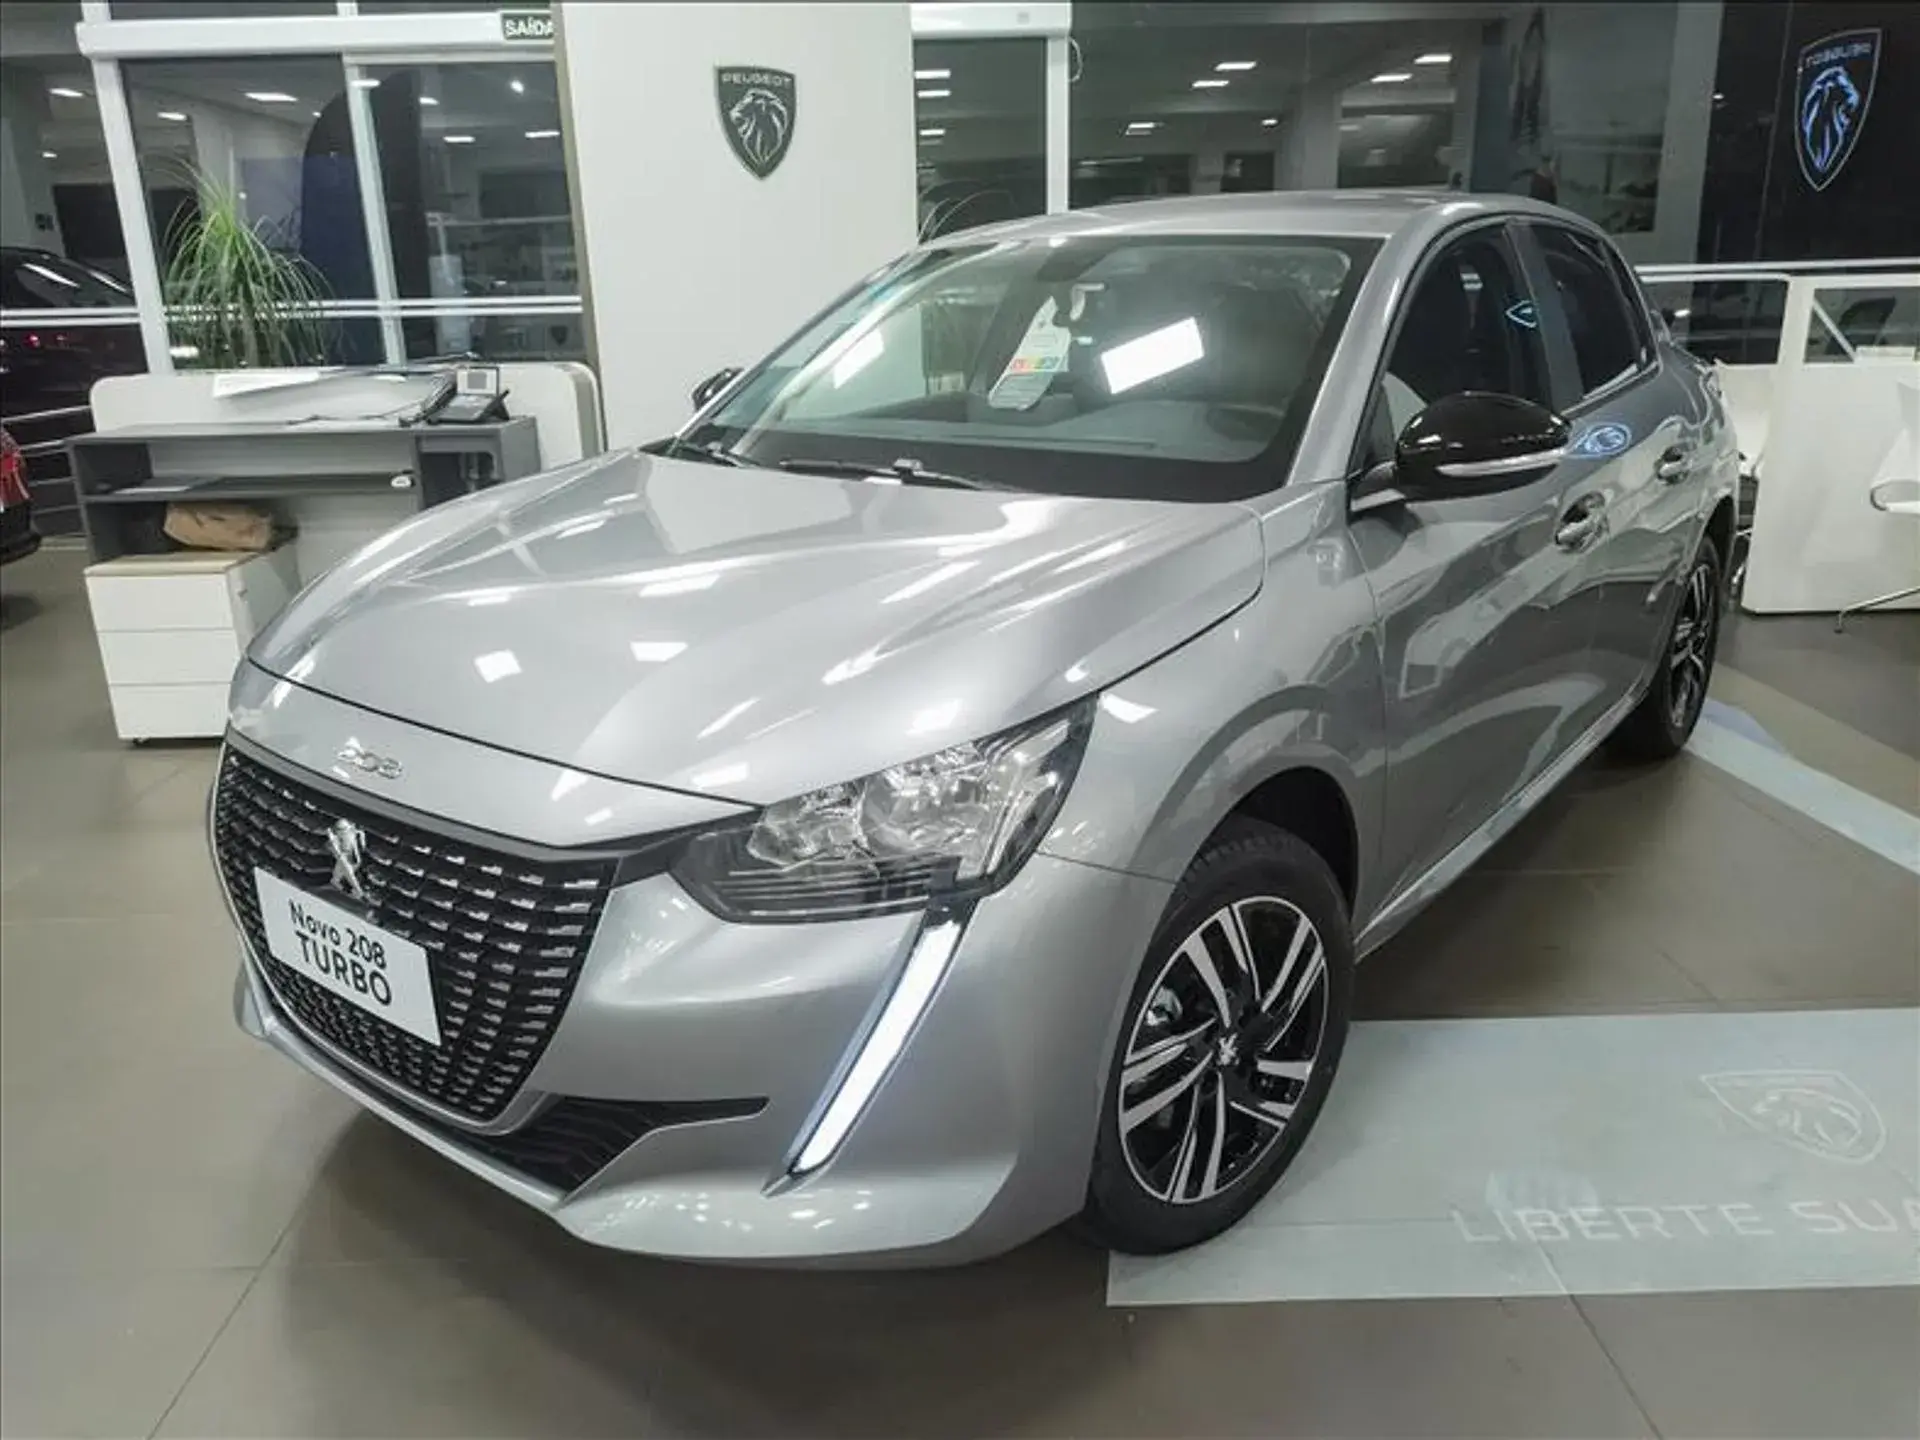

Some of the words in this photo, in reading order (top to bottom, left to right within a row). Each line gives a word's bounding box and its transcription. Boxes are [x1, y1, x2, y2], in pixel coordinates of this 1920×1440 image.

[721, 72, 793, 89] PEUGEOT
[288, 899, 341, 946] Novo
[346, 927, 387, 970] 208
[295, 930, 392, 1006] TURBO
[1451, 1203, 1775, 1242] LIBERTE
